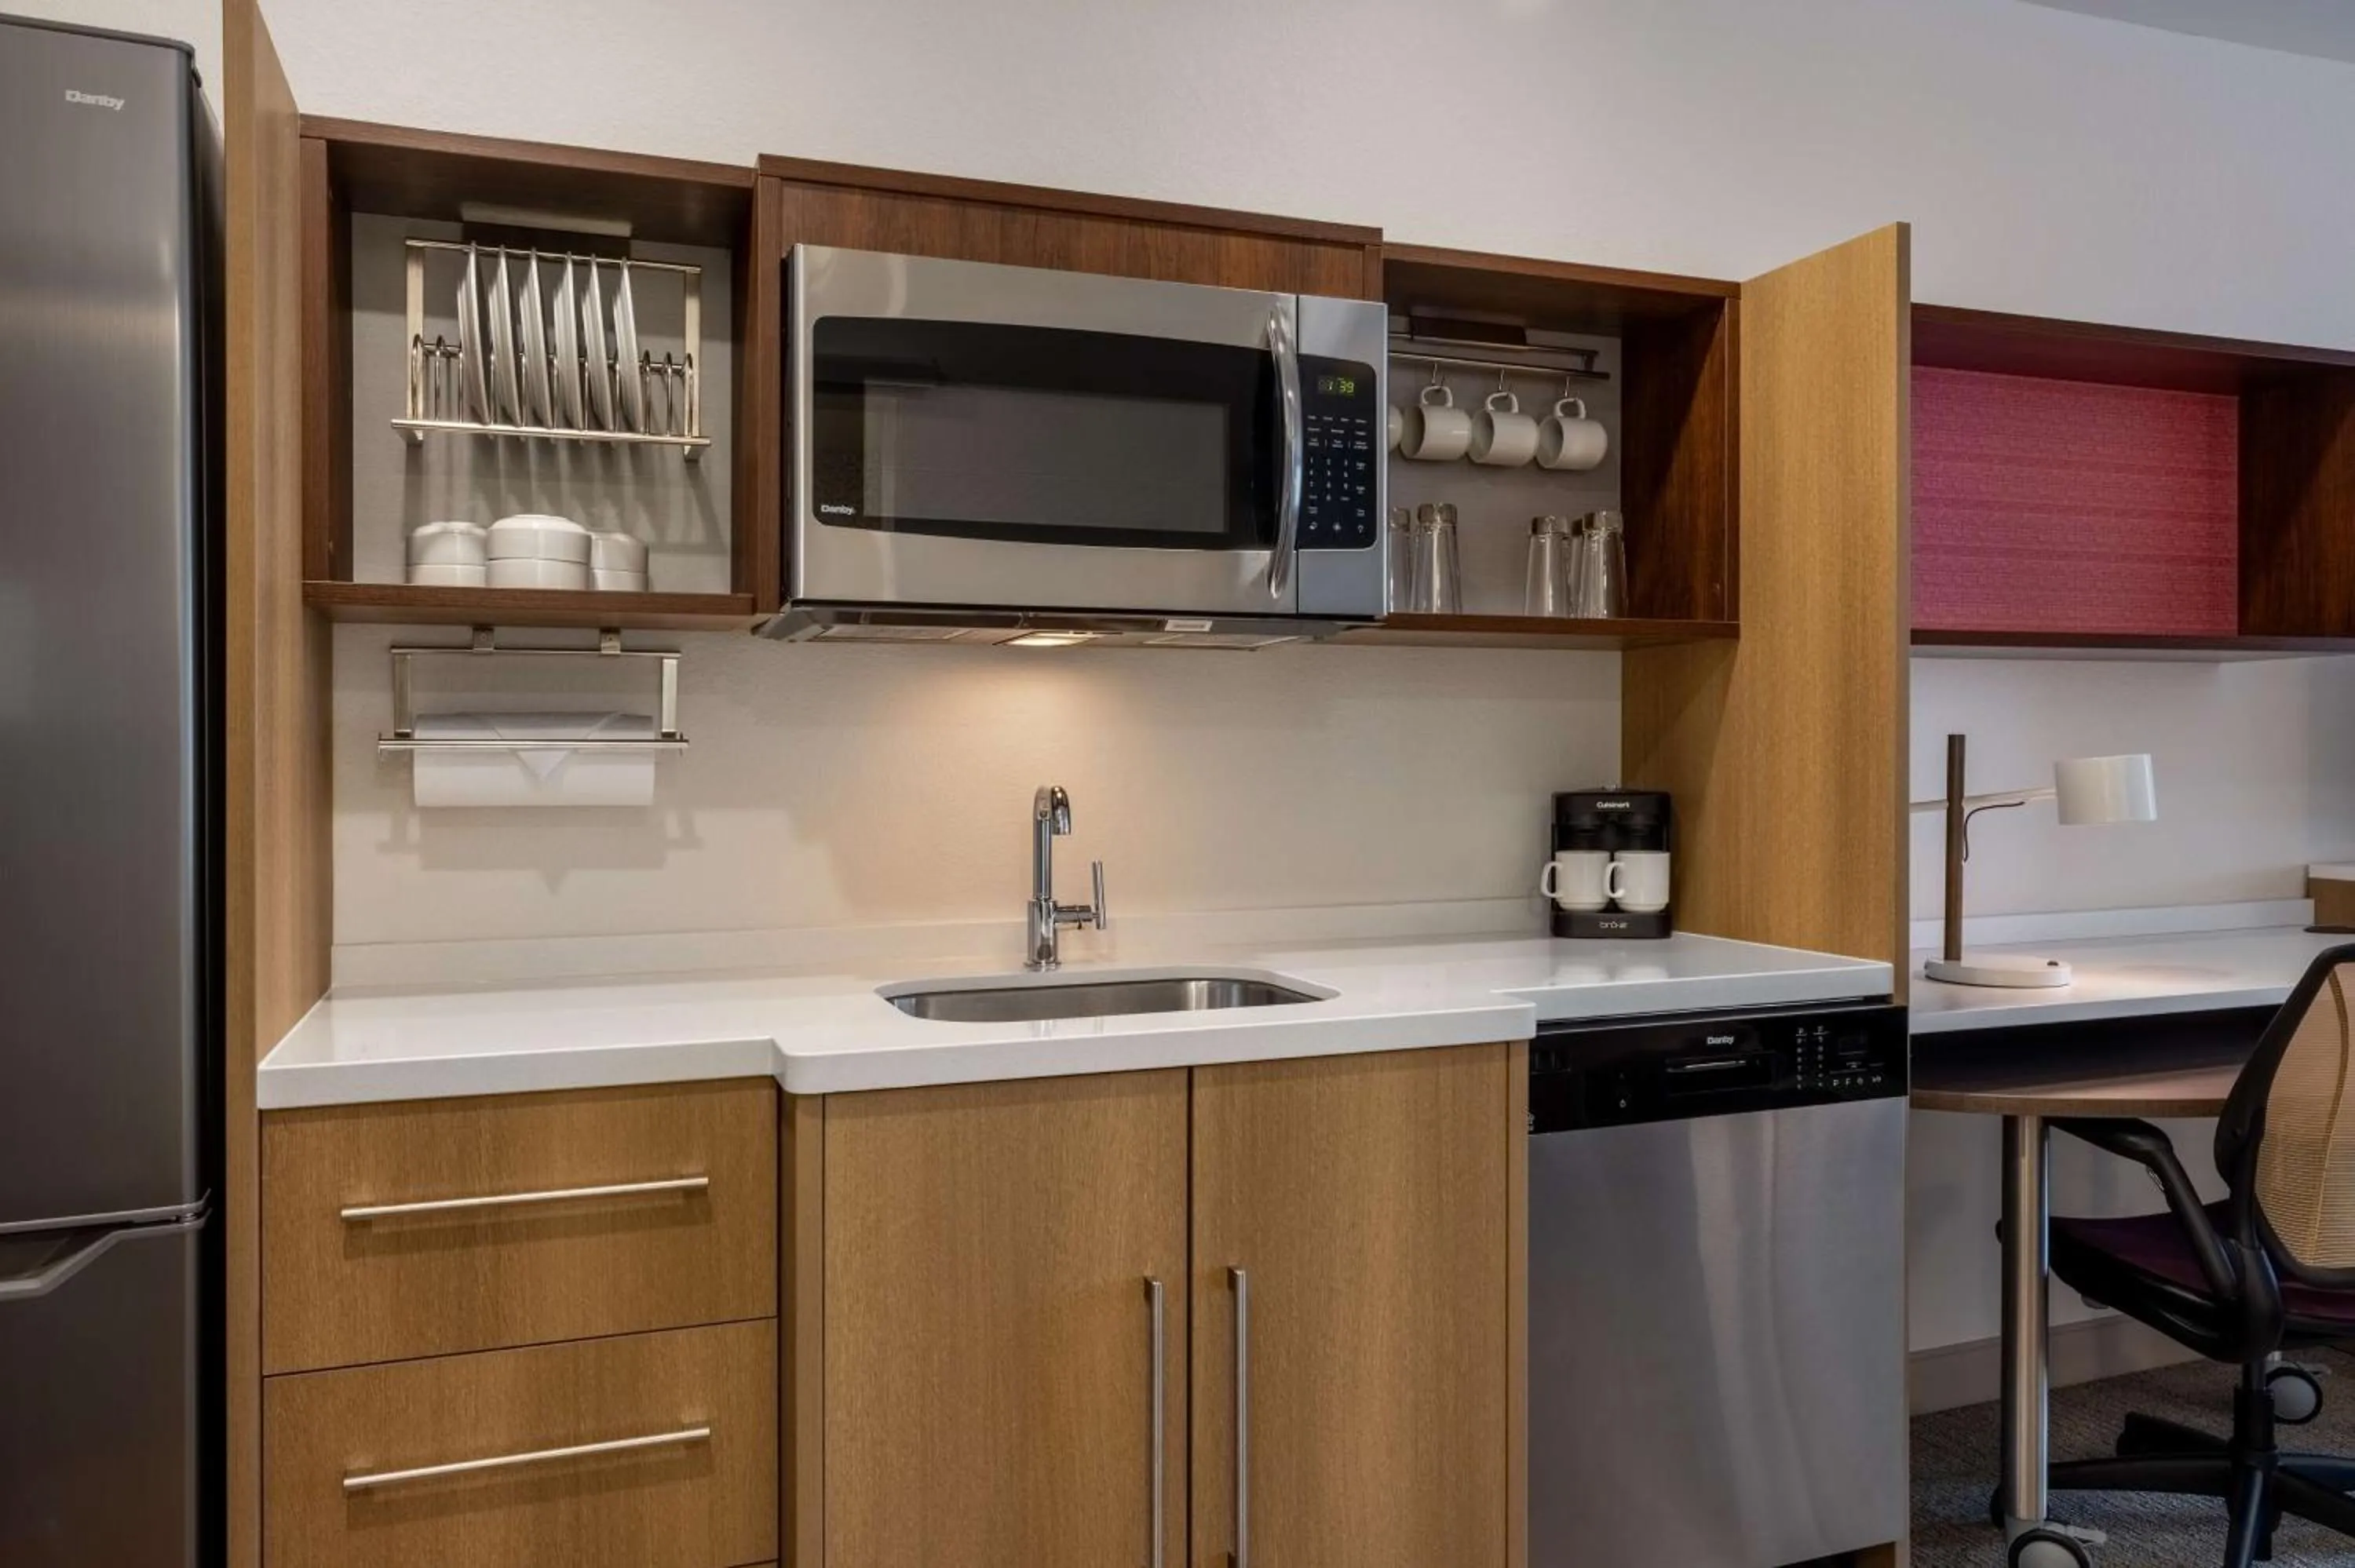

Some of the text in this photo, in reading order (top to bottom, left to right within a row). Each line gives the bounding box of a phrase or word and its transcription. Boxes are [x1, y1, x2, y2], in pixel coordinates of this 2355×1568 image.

[65, 89, 125, 111] Danby
[820, 505, 853, 516] Danby
[1707, 1035, 1734, 1045] Danby
